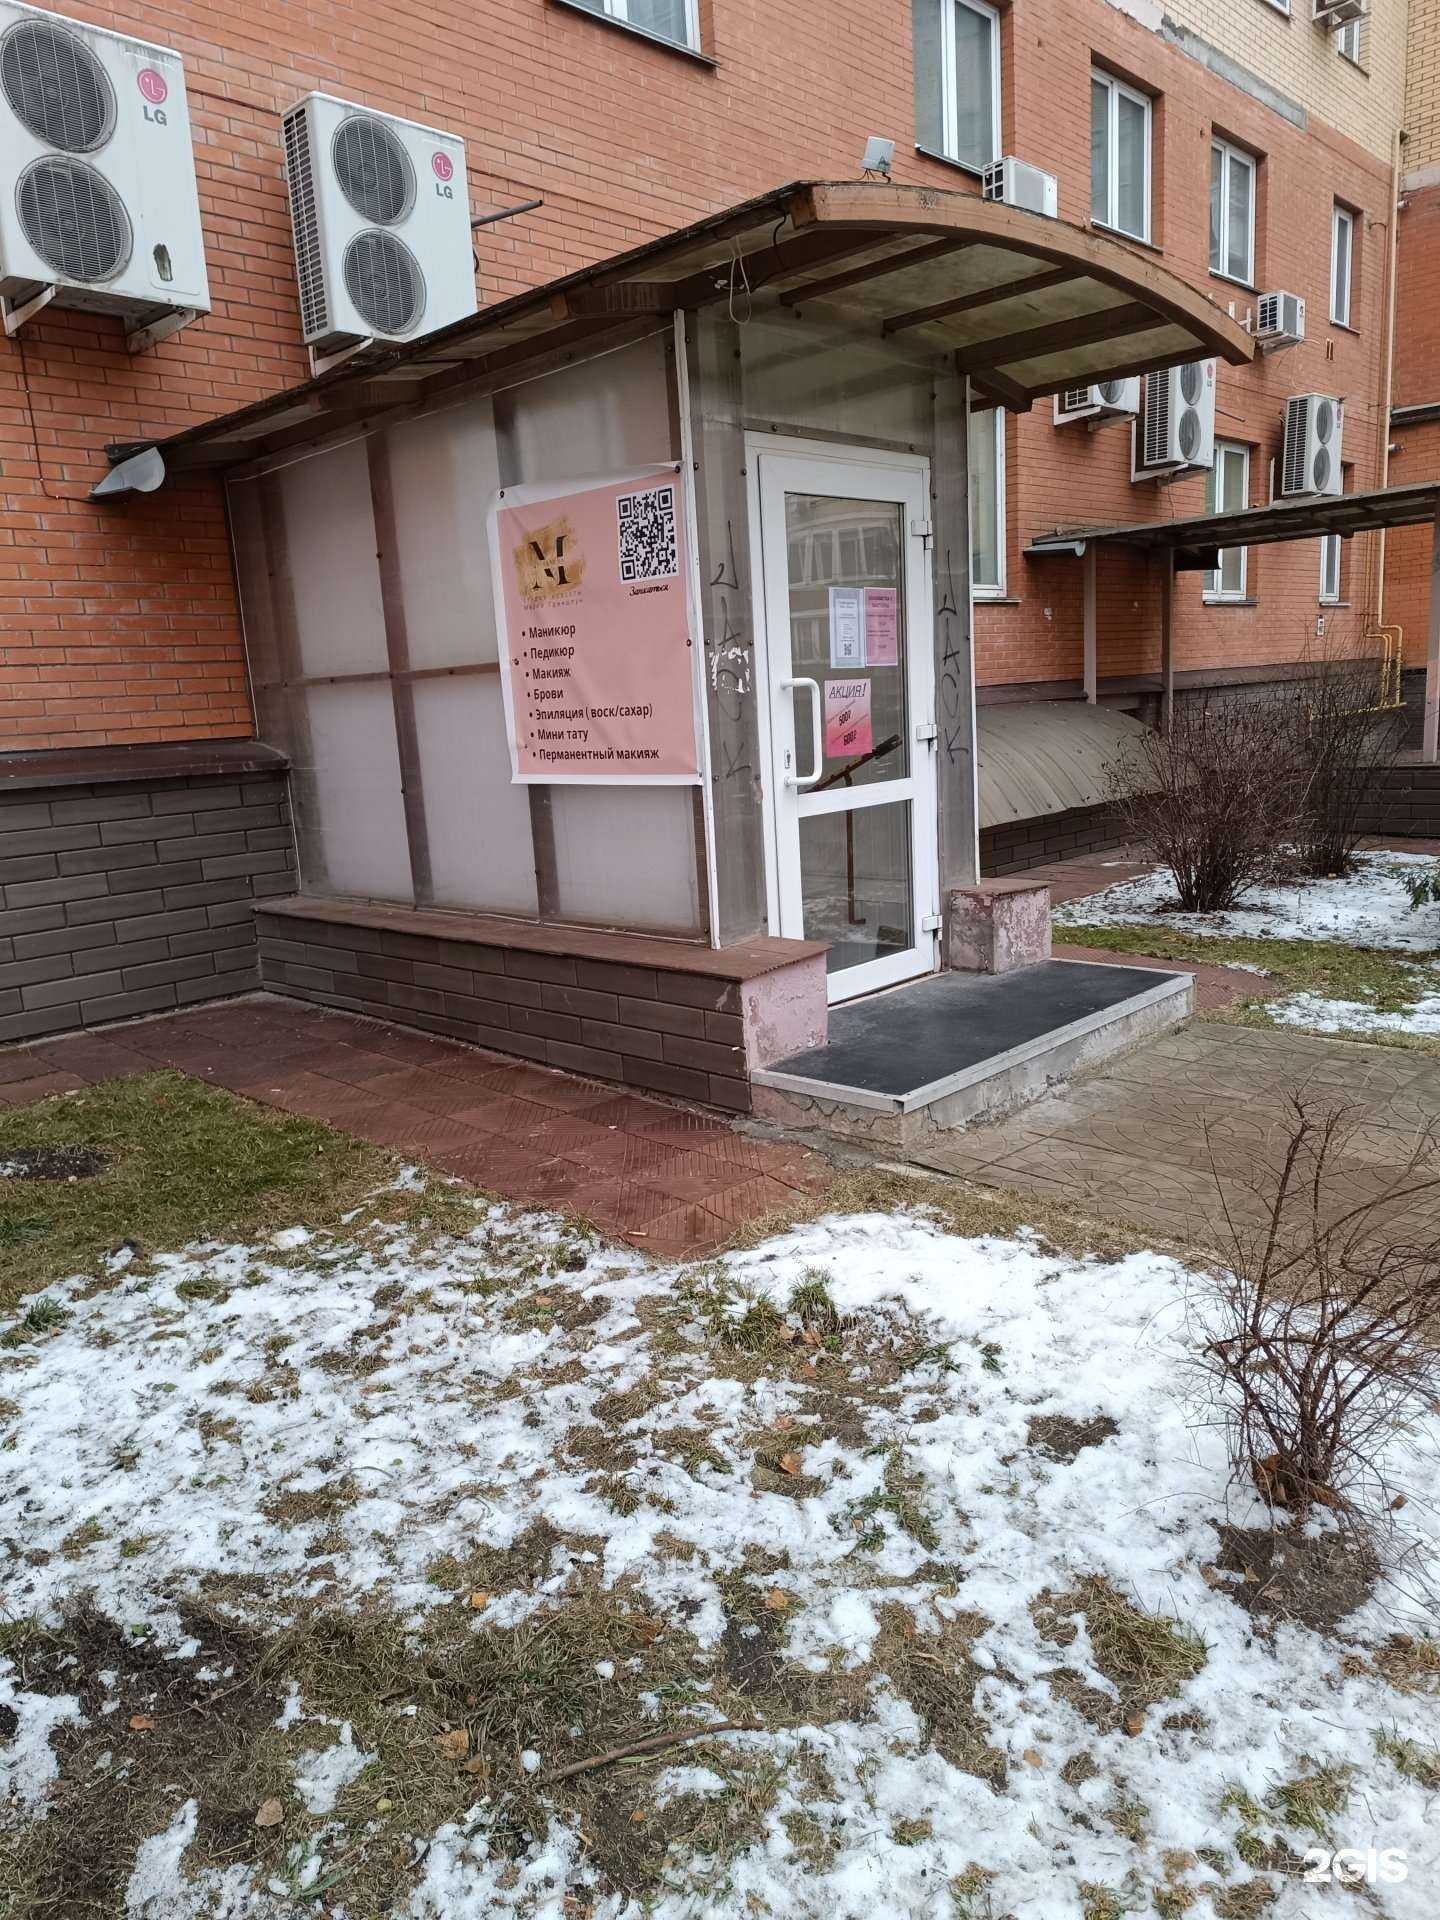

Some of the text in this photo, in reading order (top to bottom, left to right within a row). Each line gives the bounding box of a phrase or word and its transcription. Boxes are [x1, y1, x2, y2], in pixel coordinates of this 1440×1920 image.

[143, 104, 168, 127] LG
[435, 182, 454, 200] LG
[529, 624, 576, 639] Маникюр
[530, 646, 575, 661] Педикюр
[532, 668, 571, 680] Макияж
[533, 688, 564, 703] Брови
[829, 681, 867, 699] АКЦИЯ!
[536, 708, 584, 722] Эпиляция
[537, 729, 589, 742] Мини тату
[539, 747, 660, 763] Перманентный макияж
